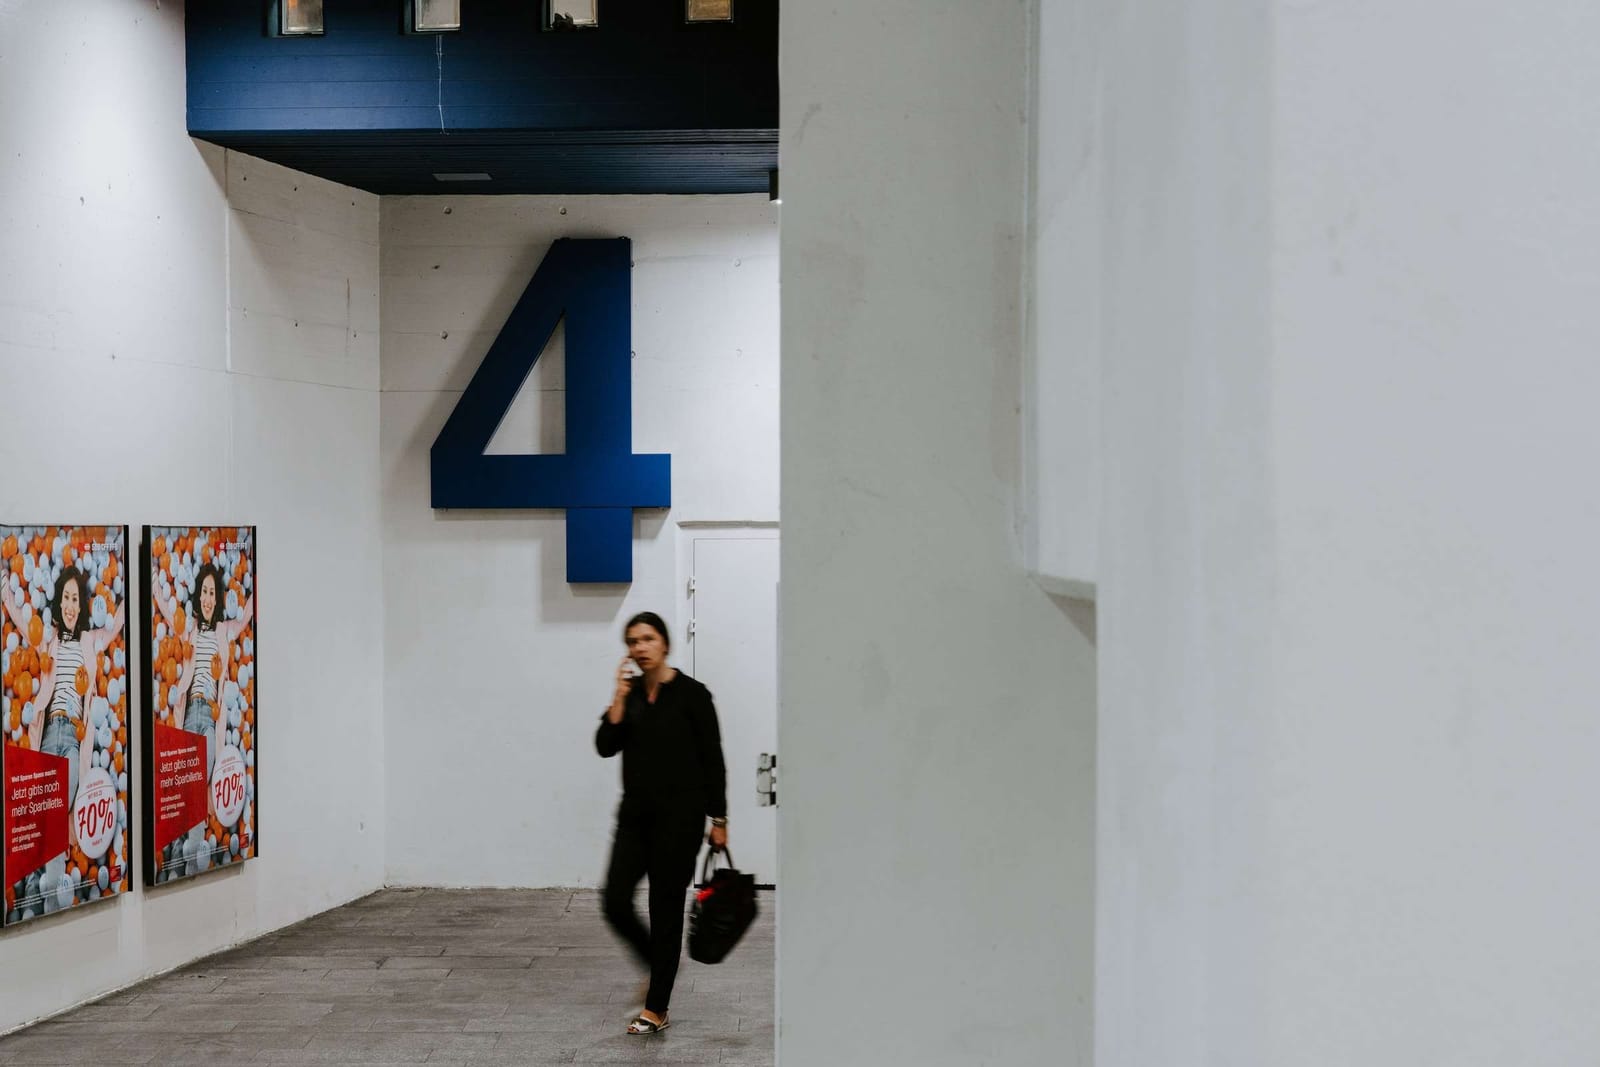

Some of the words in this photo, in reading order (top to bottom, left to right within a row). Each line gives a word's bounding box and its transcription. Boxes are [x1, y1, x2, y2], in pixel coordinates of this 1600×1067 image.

[431, 237, 671, 583] 4
[187, 756, 200, 766] noch
[11, 788, 27, 801] Jetzt
[27, 783, 44, 799] gibts
[44, 780, 60, 793] noch
[11, 804, 28, 817] mehr
